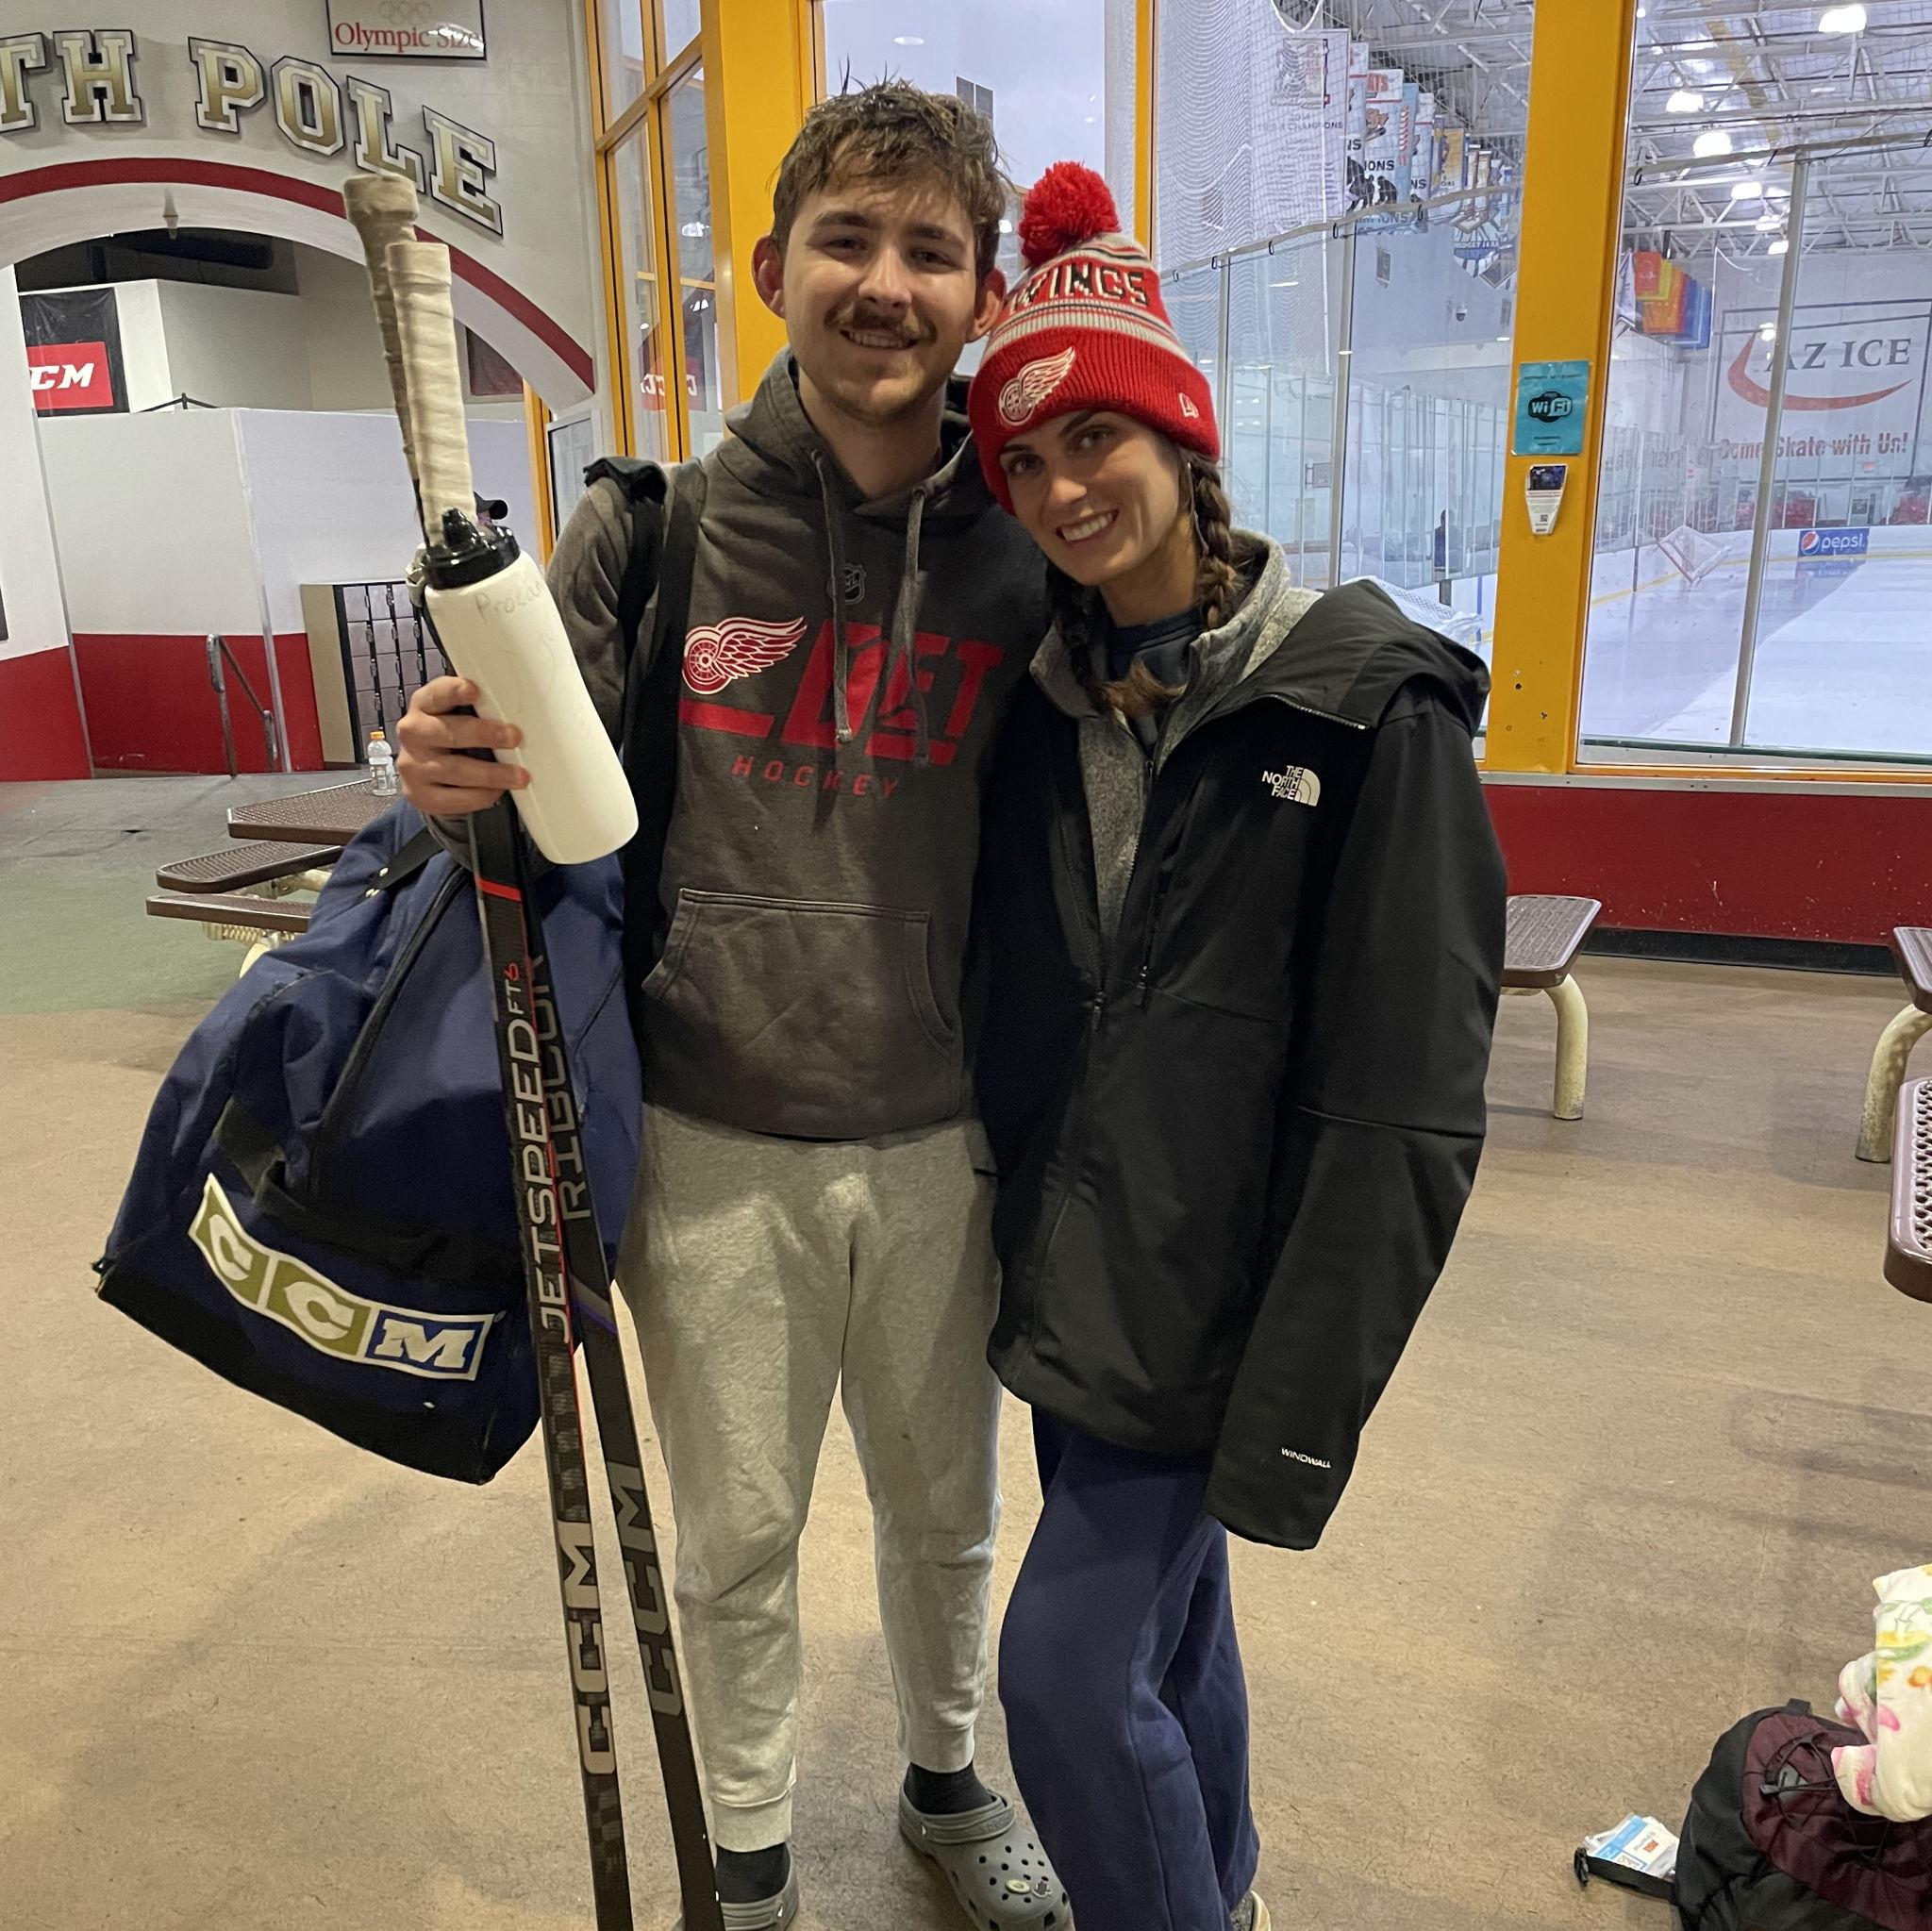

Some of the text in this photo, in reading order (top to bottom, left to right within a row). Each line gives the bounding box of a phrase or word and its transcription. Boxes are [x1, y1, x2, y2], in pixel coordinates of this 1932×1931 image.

[334, 22, 430, 53] Olympic
[189, 37, 503, 238] POLE
[1840, 338, 1911, 368] ICE
[1832, 433, 1872, 456] with
[1877, 431, 1909, 455] Us!
[1821, 532, 1864, 553] pepsi
[731, 755, 899, 797] HOCKEY
[1261, 770, 1300, 789] NORTH
[1286, 765, 1304, 778] THE
[1271, 785, 1297, 800] FACE
[508, 1019, 571, 1344] JETSPEED
[208, 1214, 475, 1369] CCM
[1281, 1447, 1331, 1469] WINDWALL
[607, 1461, 683, 1717] CCM
[558, 1521, 617, 1774] CCM
